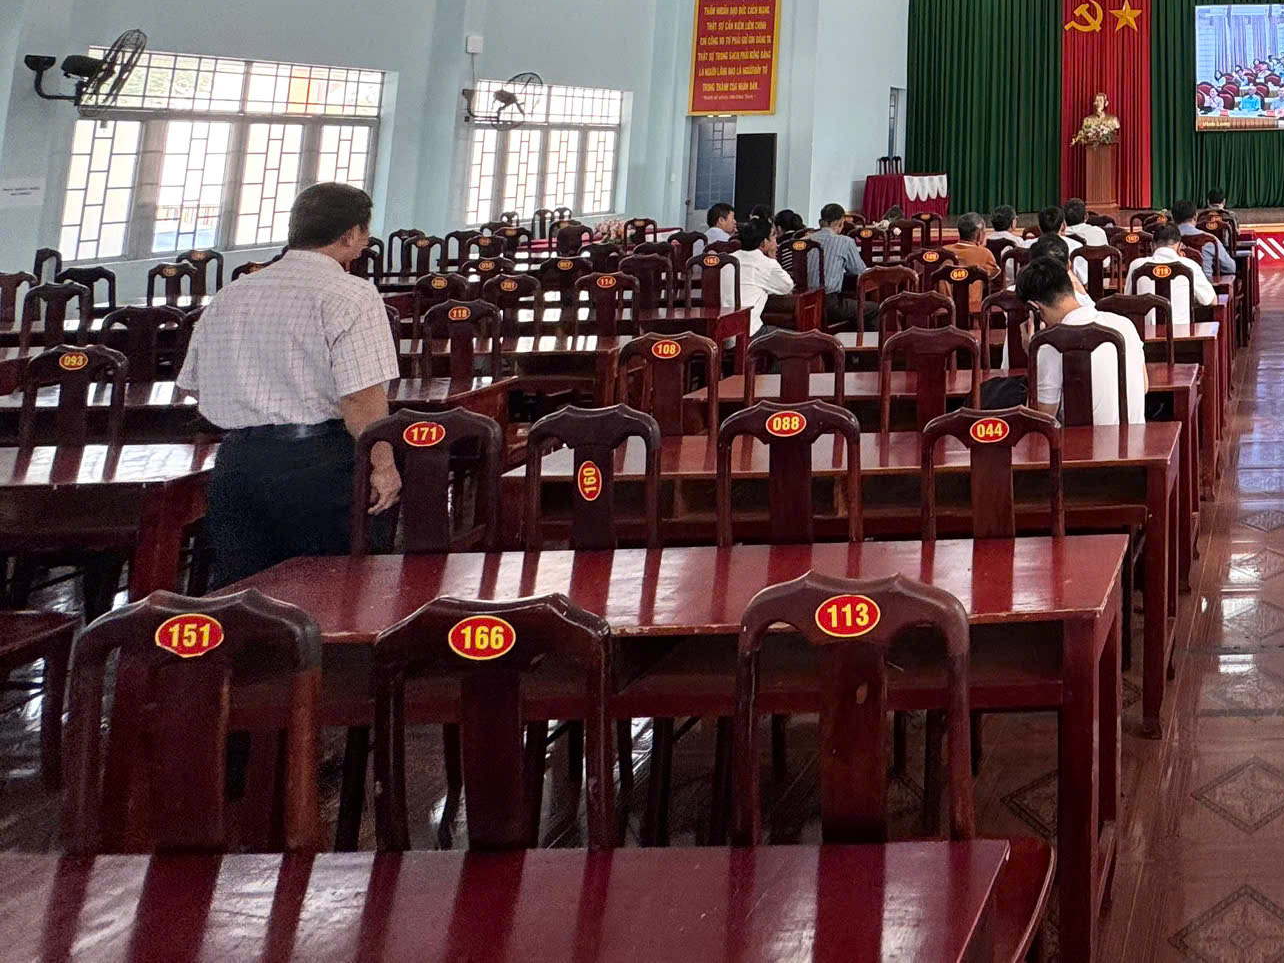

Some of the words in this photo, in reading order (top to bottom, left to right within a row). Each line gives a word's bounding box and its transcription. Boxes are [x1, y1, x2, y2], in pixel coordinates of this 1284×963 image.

[453, 308, 468, 318] 118
[657, 344, 677, 355] 108
[771, 416, 800, 432] 088
[976, 422, 1004, 438] 044
[410, 426, 438, 442] 171
[582, 467, 595, 494] 160
[825, 603, 870, 628] 113
[168, 623, 210, 648] 151
[460, 625, 503, 650] 166
